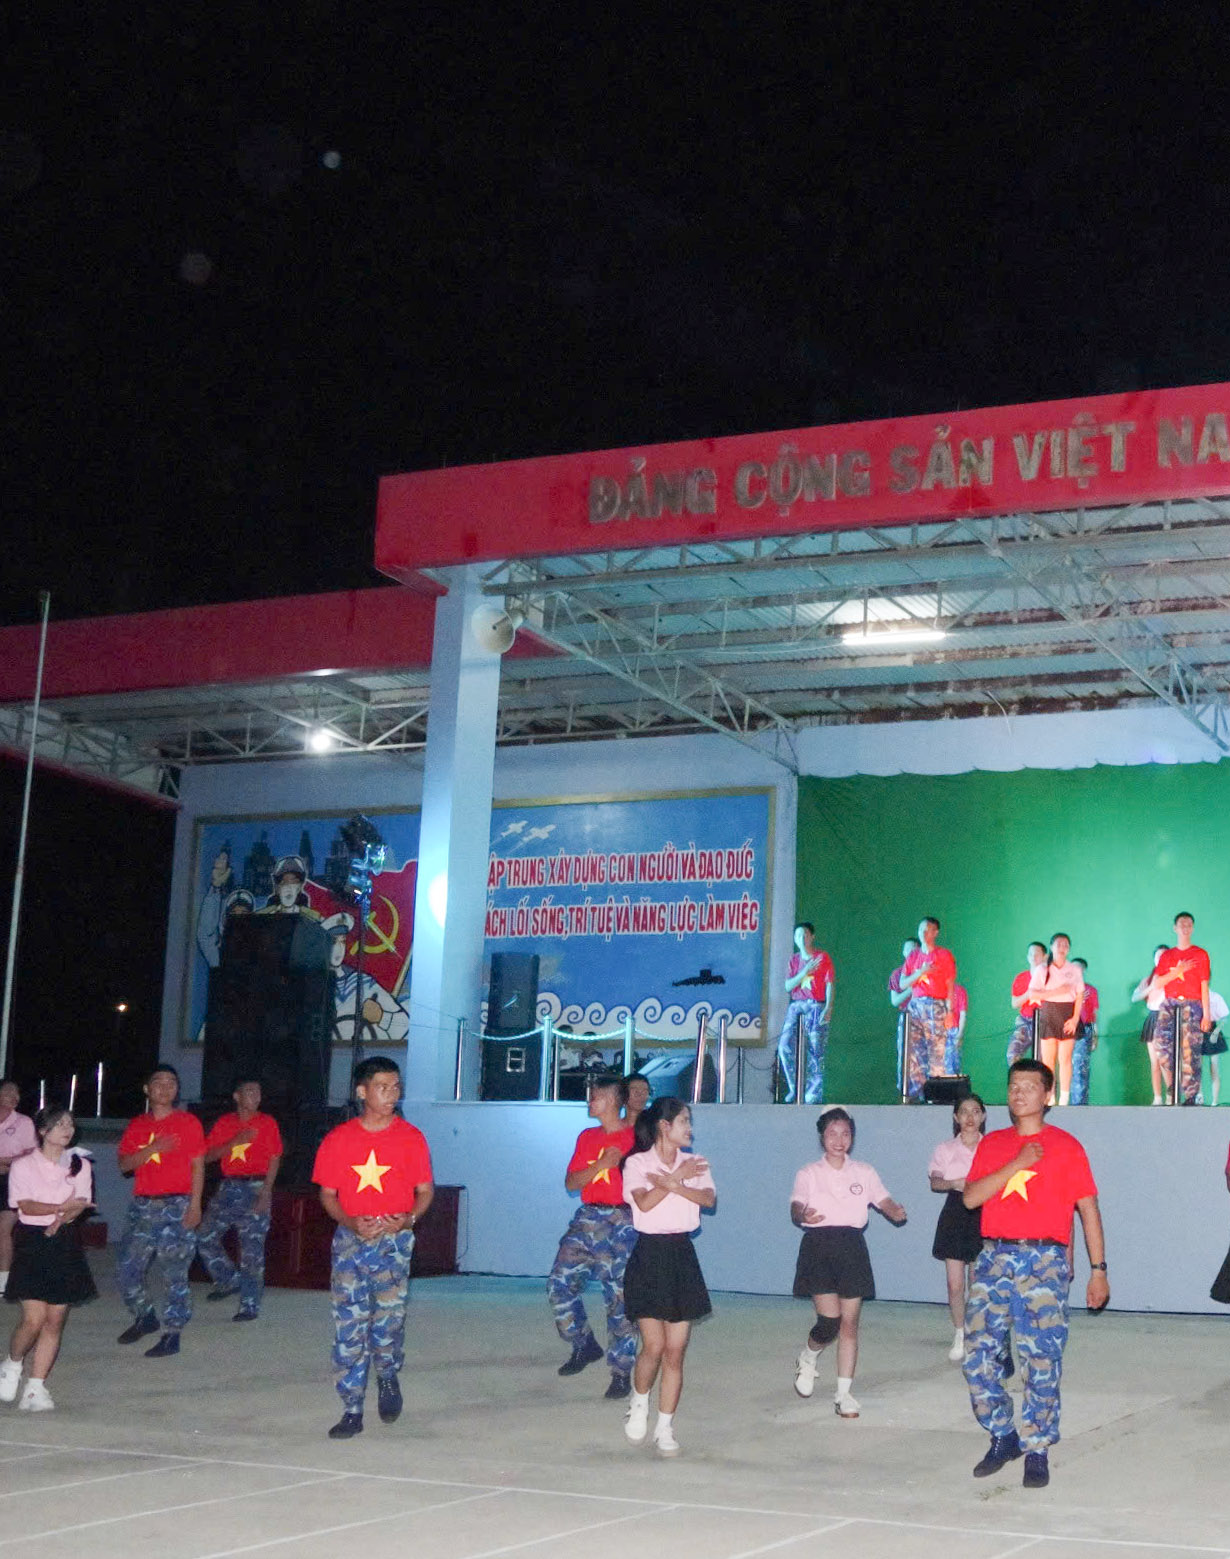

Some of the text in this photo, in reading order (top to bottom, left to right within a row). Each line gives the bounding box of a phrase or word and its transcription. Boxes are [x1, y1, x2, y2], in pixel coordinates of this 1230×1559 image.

[588, 456, 717, 523] ĐẢNG
[734, 443, 871, 517] CỘNG
[889, 424, 994, 494] SẢN
[1012, 412, 1136, 489] VIỆT
[487, 851, 505, 895] ẬP
[507, 857, 546, 888] TRUNG
[572, 848, 607, 891] DỰNG
[608, 852, 636, 884] CON
[638, 840, 679, 883] NGƯỜI
[680, 841, 697, 882] VÀ
[698, 849, 725, 888] ĐẠO
[725, 838, 755, 883] ĐỨC
[484, 900, 508, 938] ÁCH
[508, 895, 530, 937] LỐI
[590, 895, 614, 942] TUỆ
[615, 896, 631, 935] VÀ
[631, 896, 667, 934] NĂNG
[668, 895, 697, 941] LỰC
[697, 893, 726, 933] LÀM
[726, 892, 760, 940] VIỆC
